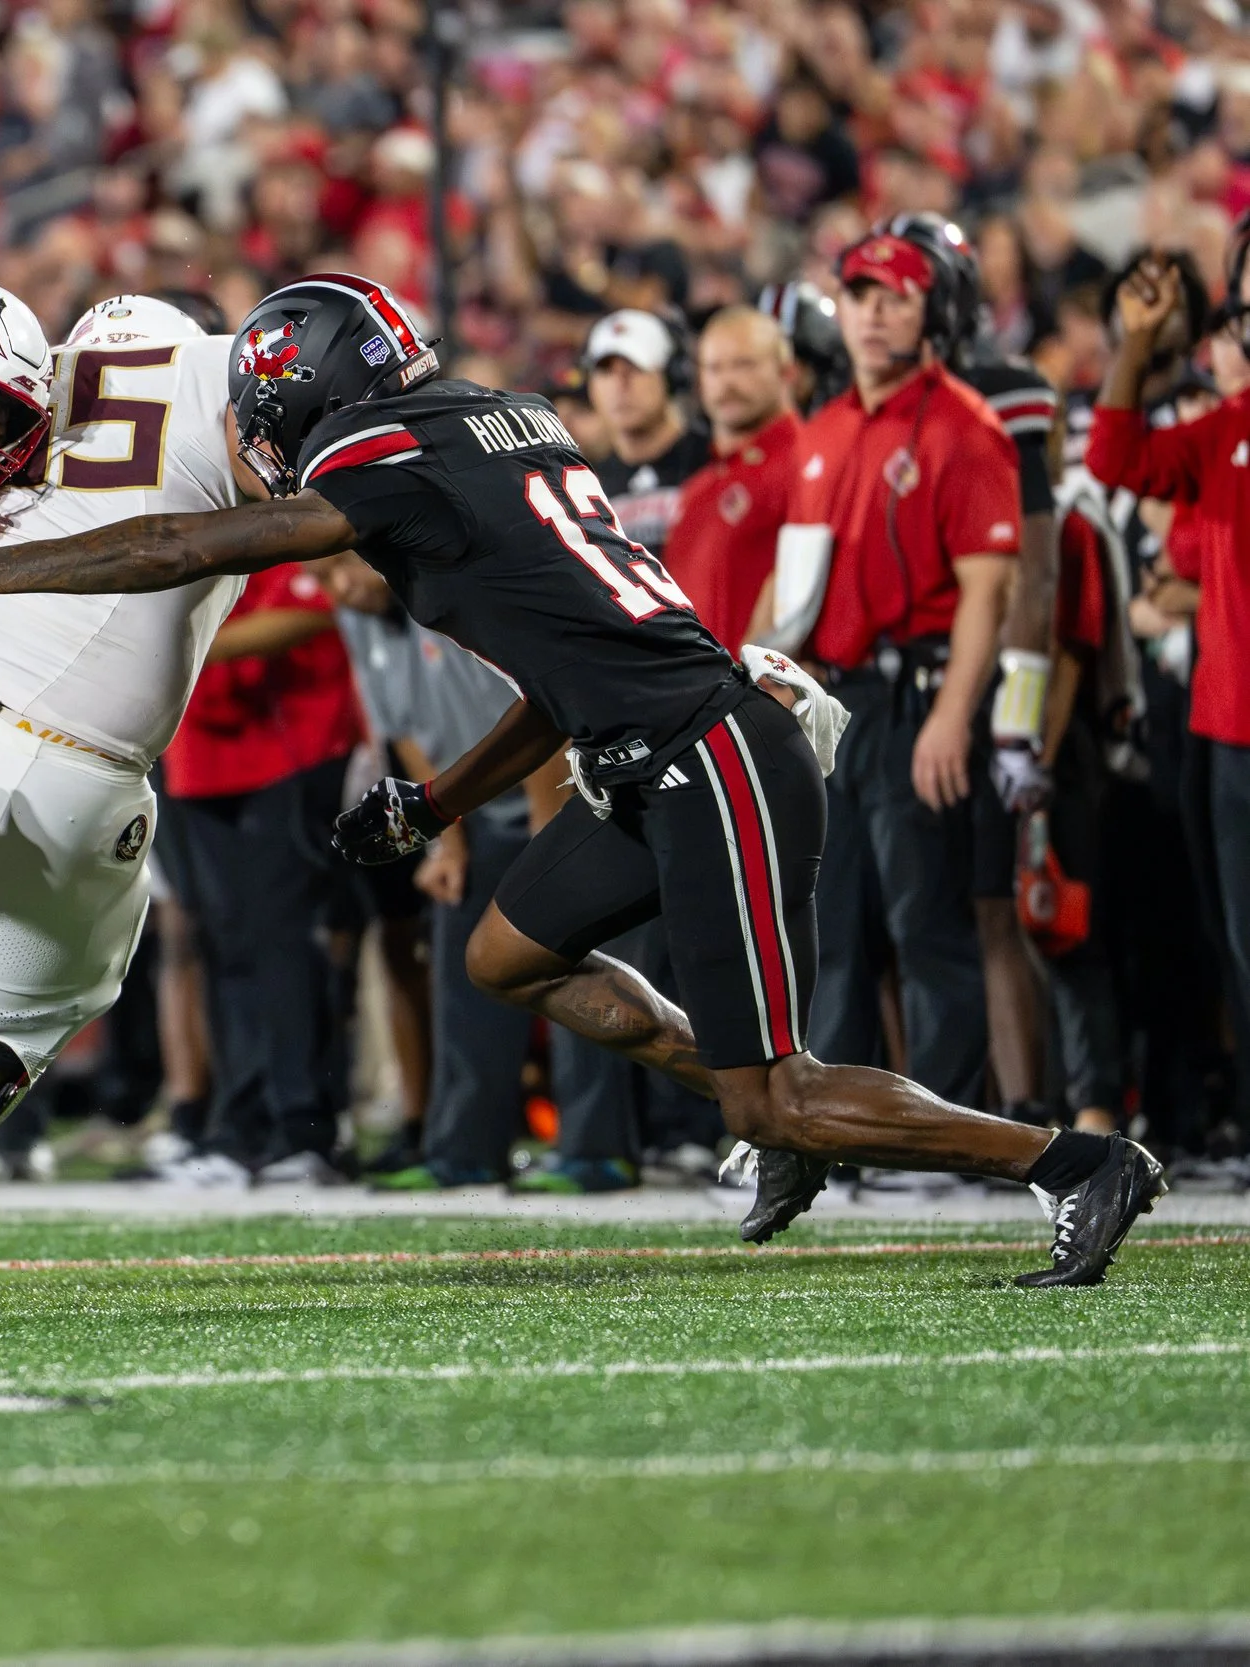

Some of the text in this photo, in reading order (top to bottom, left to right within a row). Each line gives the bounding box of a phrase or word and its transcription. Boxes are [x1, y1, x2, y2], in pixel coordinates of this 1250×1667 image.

[14, 345, 180, 493] 5
[363, 339, 382, 354] USA
[524, 465, 696, 625] 13
